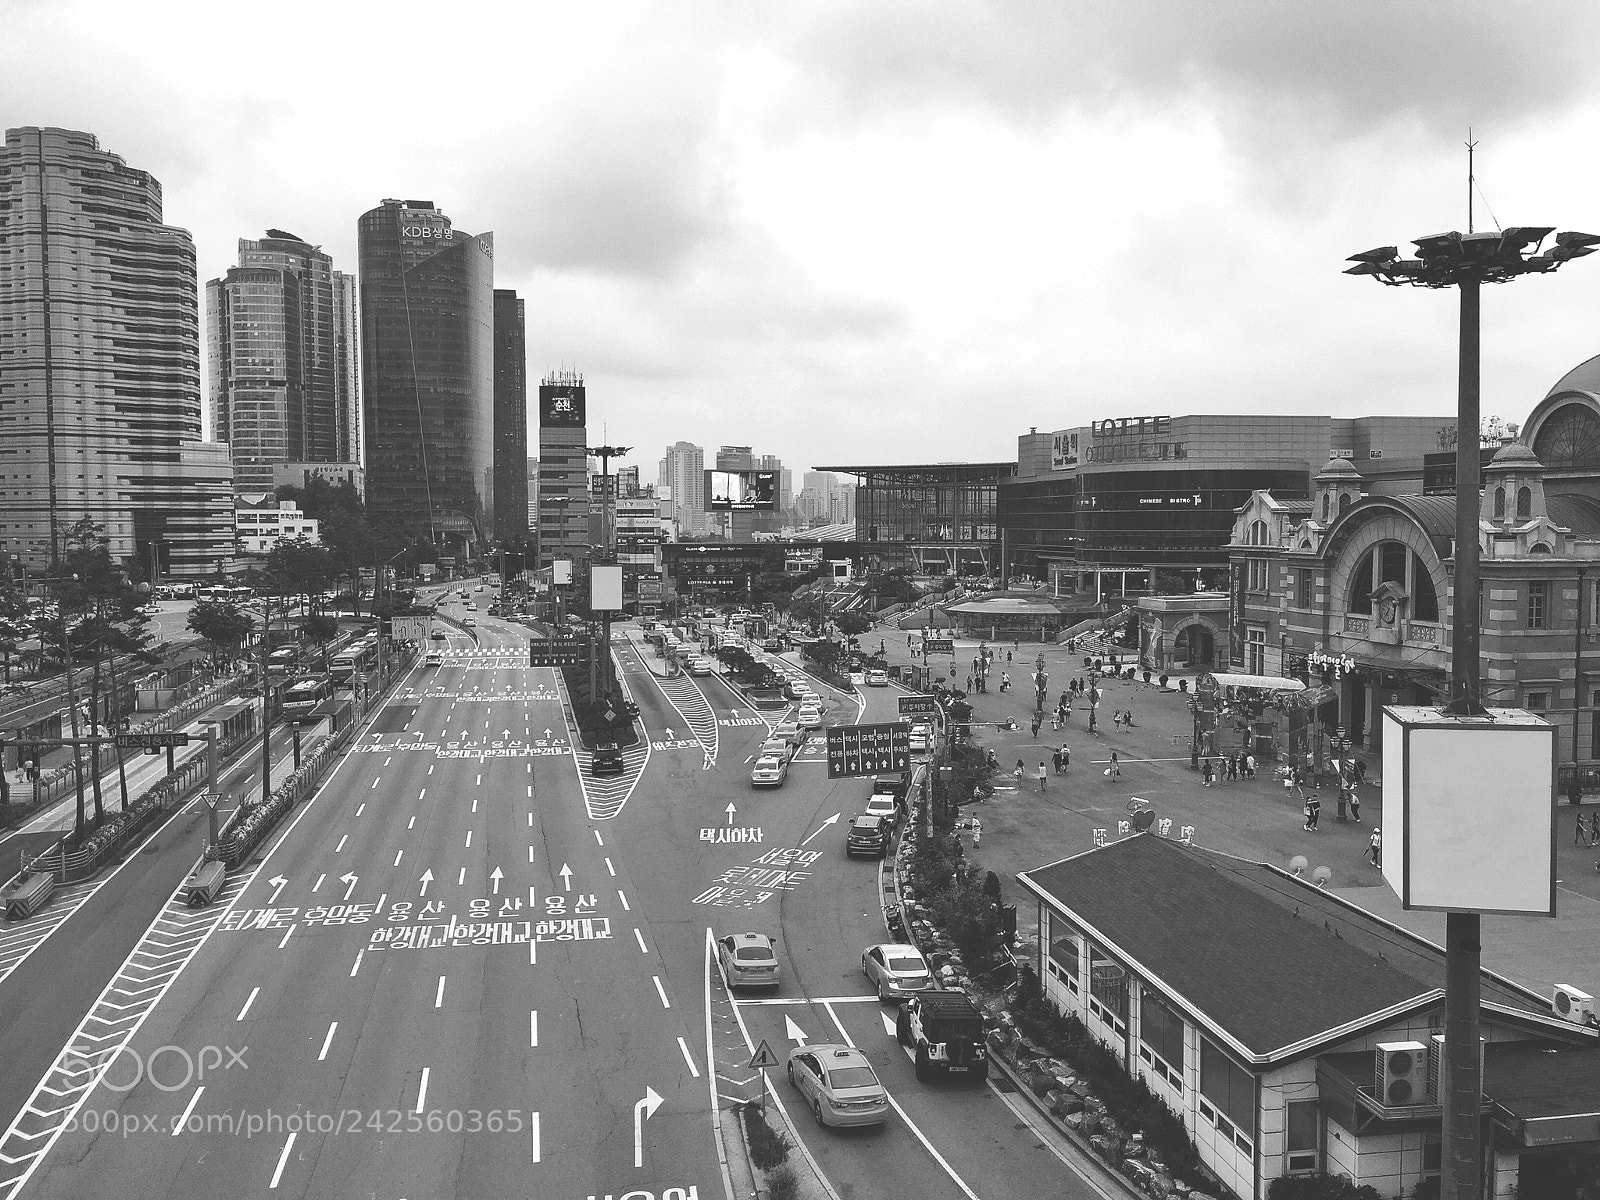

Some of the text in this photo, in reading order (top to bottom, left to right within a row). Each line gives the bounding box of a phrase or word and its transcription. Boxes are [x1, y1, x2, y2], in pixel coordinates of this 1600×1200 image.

[402, 226, 453, 240] KDB생명
[1092, 415, 1171, 438] LOTTE
[117, 735, 186, 747] 버스전용차로
[699, 827, 763, 843] 택시하차
[751, 847, 823, 867] 서울역
[712, 865, 812, 890] 롯데마트
[217, 907, 300, 931] 퇴계로
[301, 903, 376, 926] 후암동
[367, 924, 450, 951] 한강대교
[452, 921, 530, 946] 한강대교
[535, 917, 613, 943] 한강대교
